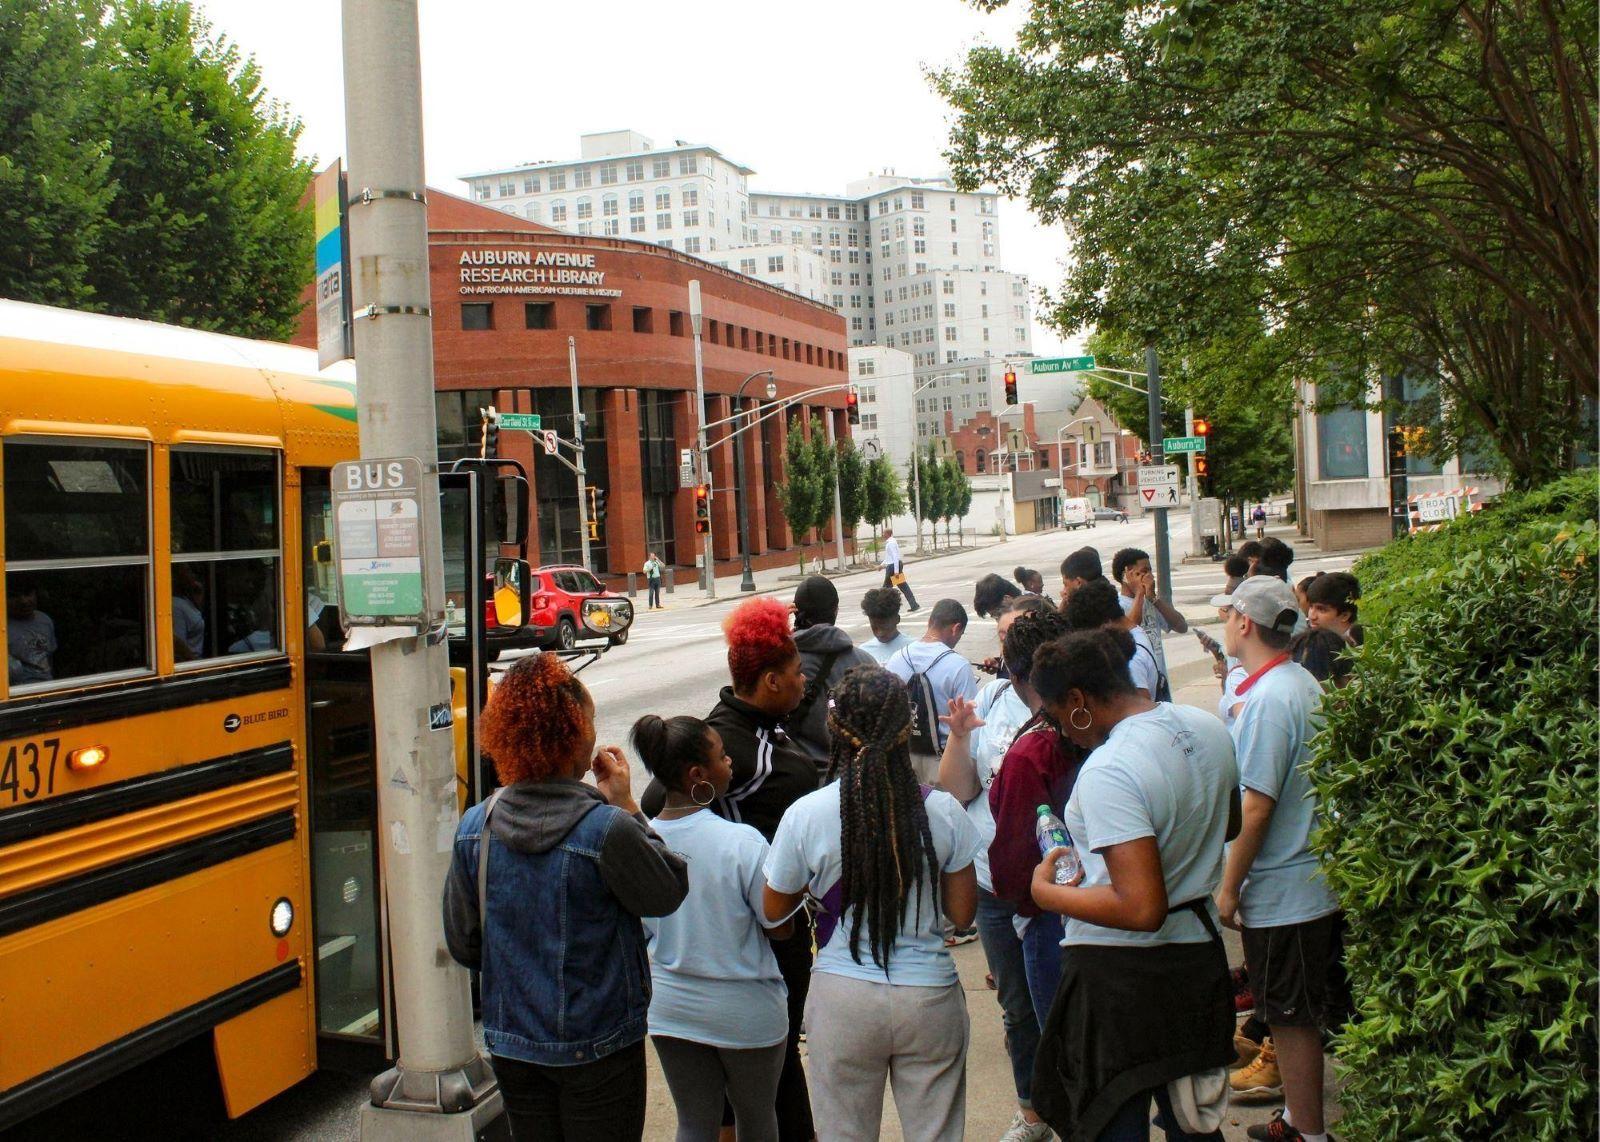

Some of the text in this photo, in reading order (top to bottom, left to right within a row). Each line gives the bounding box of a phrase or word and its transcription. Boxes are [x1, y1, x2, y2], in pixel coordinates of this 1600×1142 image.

[459, 250, 596, 268] AUBURN AVENUE
[460, 268, 606, 285] RESEARCH LIBRARY
[459, 286, 475, 295] ON
[476, 285, 513, 295] AFRICAN
[514, 286, 556, 295] AMERICAN
[1033, 362, 1060, 373] Auburn
[1062, 360, 1072, 370] Av
[1167, 440, 1194, 450] Auburn
[346, 462, 404, 491] BUS
[1426, 499, 1448, 508] ROA
[243, 708, 289, 725] BLUE BIRD
[0, 737, 61, 803] 437
